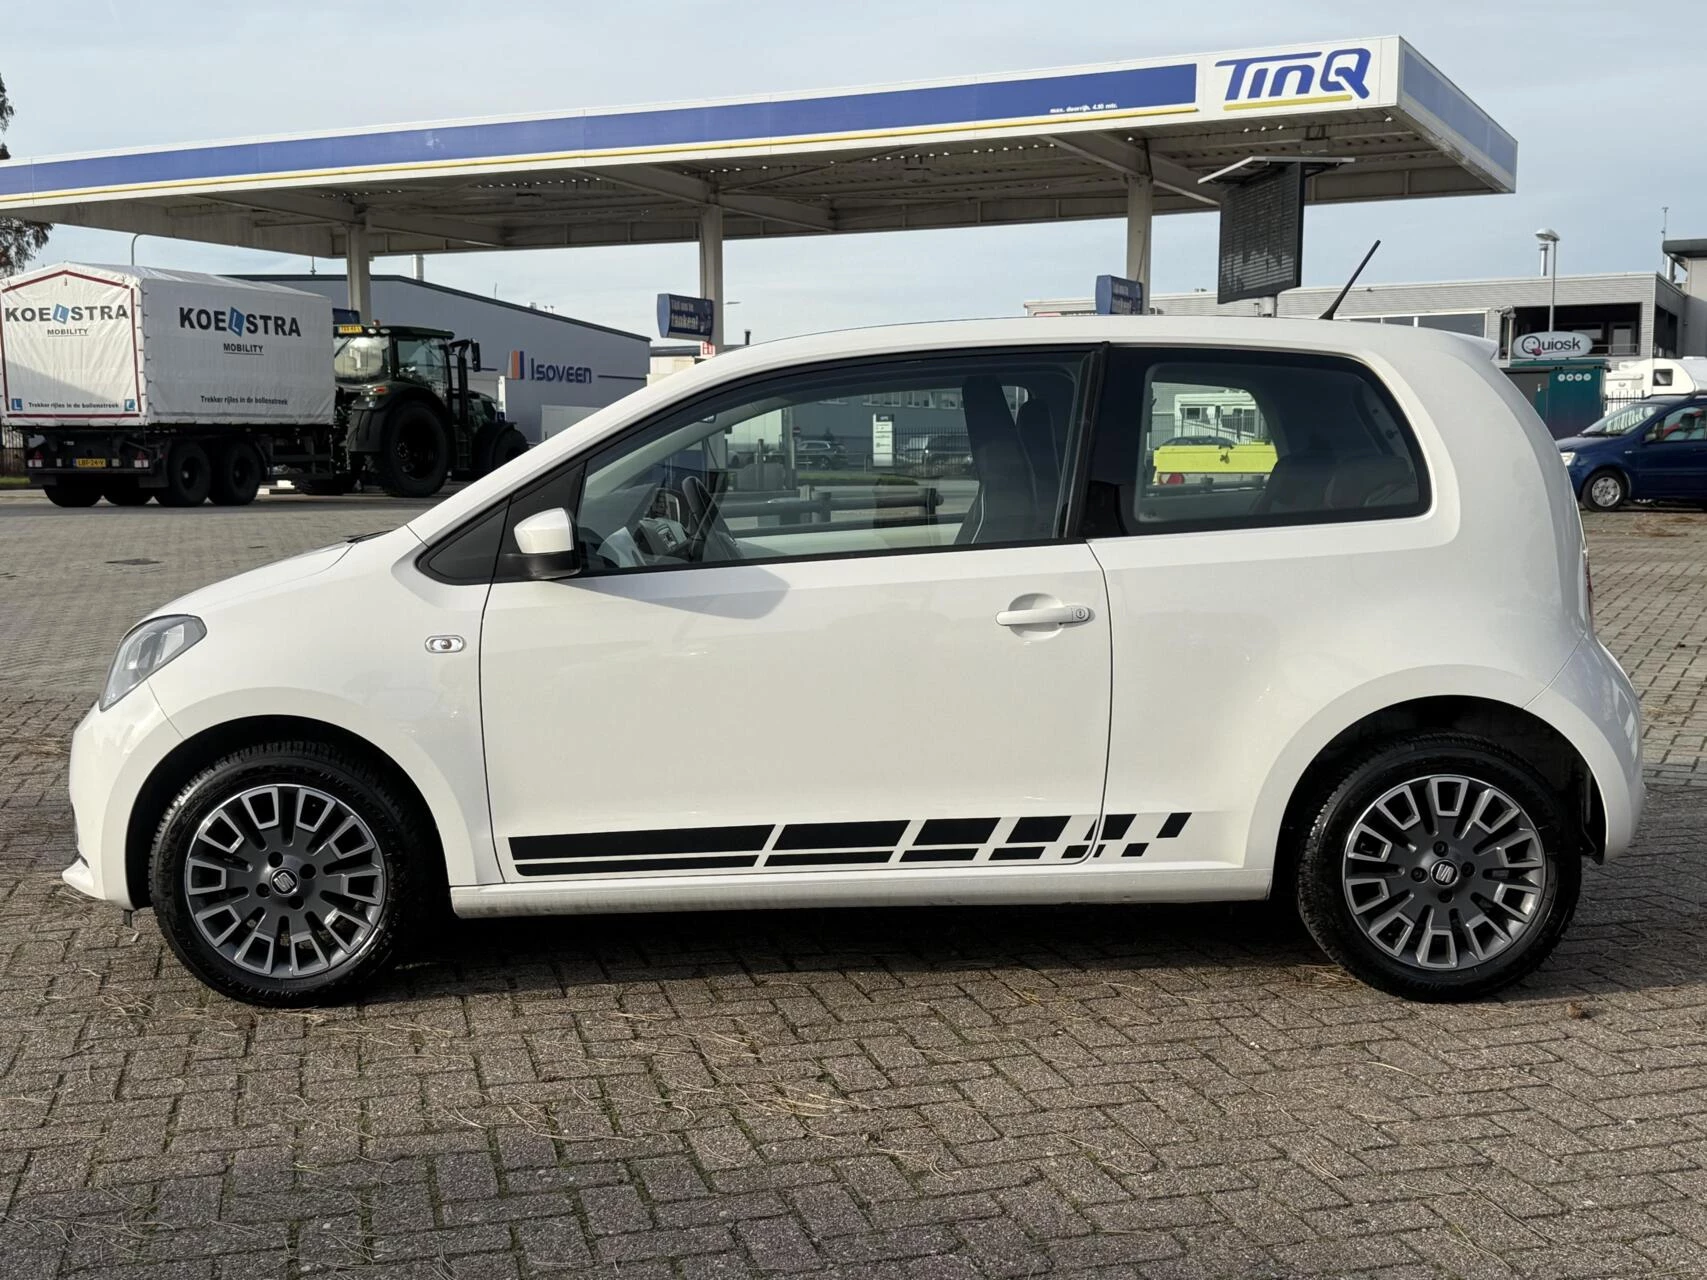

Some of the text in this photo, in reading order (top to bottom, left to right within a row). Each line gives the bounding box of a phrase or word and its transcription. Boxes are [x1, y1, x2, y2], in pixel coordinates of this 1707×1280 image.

[5, 303, 130, 325] KOELSTRA
[179, 306, 302, 338] KOELSTRA
[47, 328, 89, 336] MOBILITY
[223, 343, 264, 353] MOBILITY
[1521, 335, 1581, 356] Quiosk
